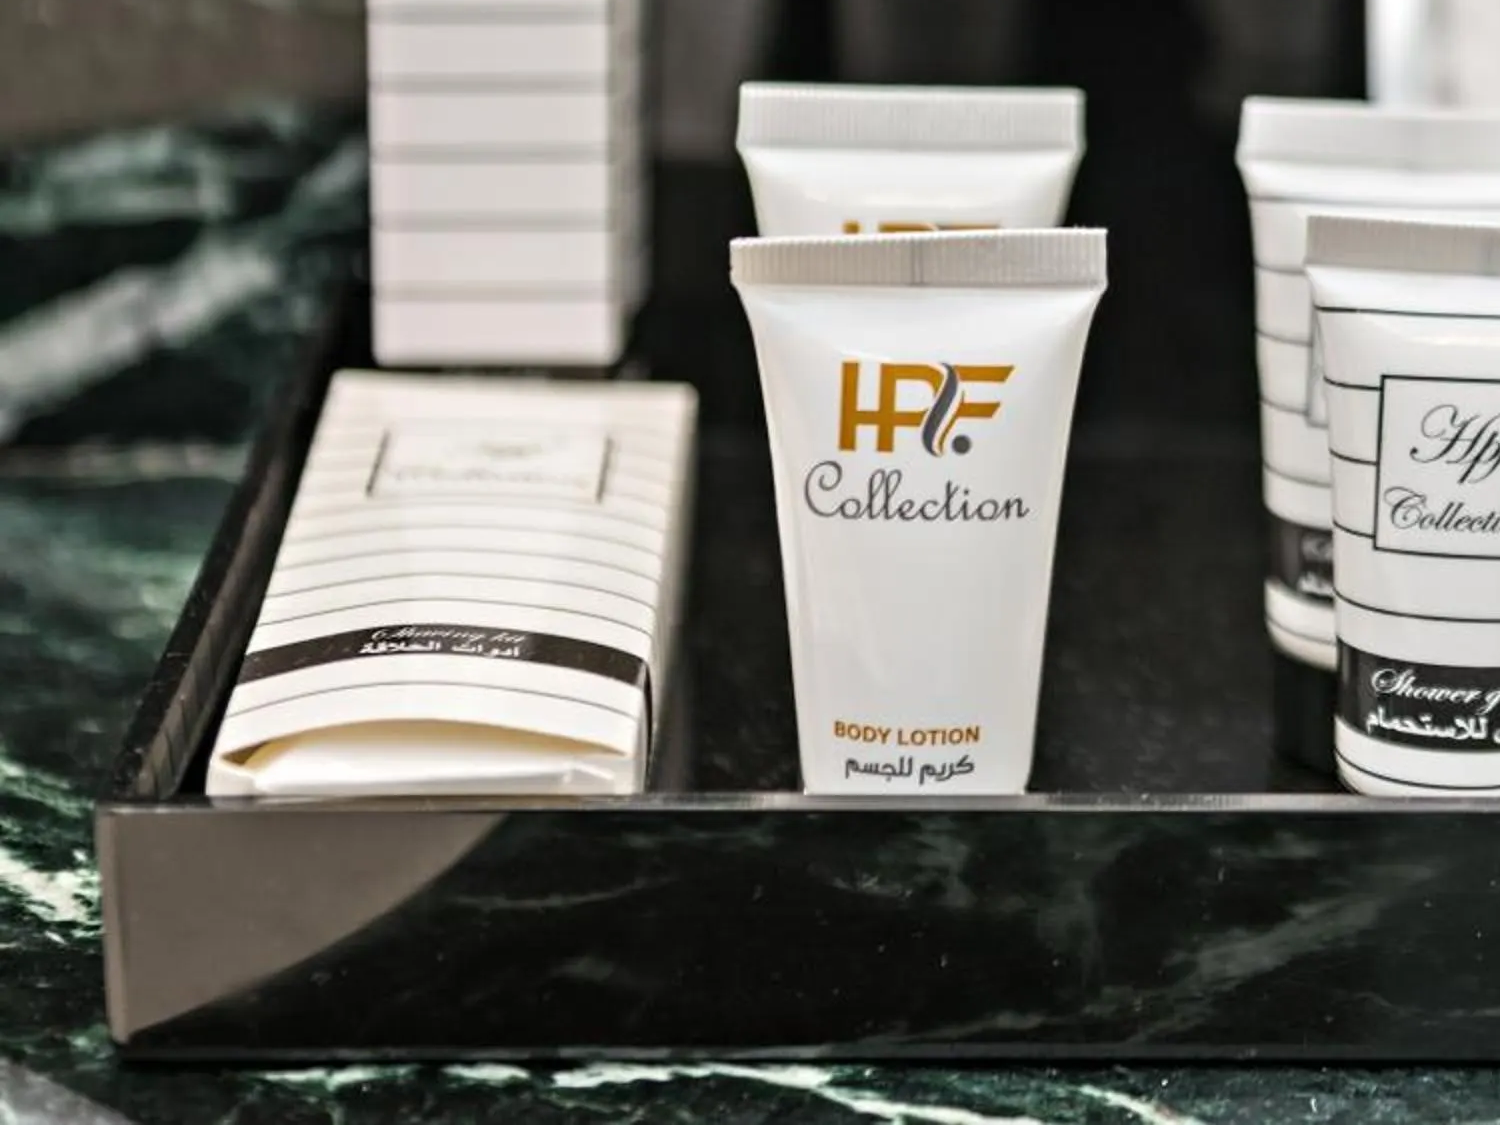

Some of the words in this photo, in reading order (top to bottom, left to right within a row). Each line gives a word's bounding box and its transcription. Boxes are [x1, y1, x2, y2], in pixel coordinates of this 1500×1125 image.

[804, 460, 1030, 522] Collection
[1371, 669, 1482, 703] Shower
[834, 721, 891, 743] BODY
[897, 725, 981, 746] LOTION
[1366, 706, 1488, 740] للاستحمام
[845, 756, 914, 781] للجسم
[919, 754, 975, 785] كريم
